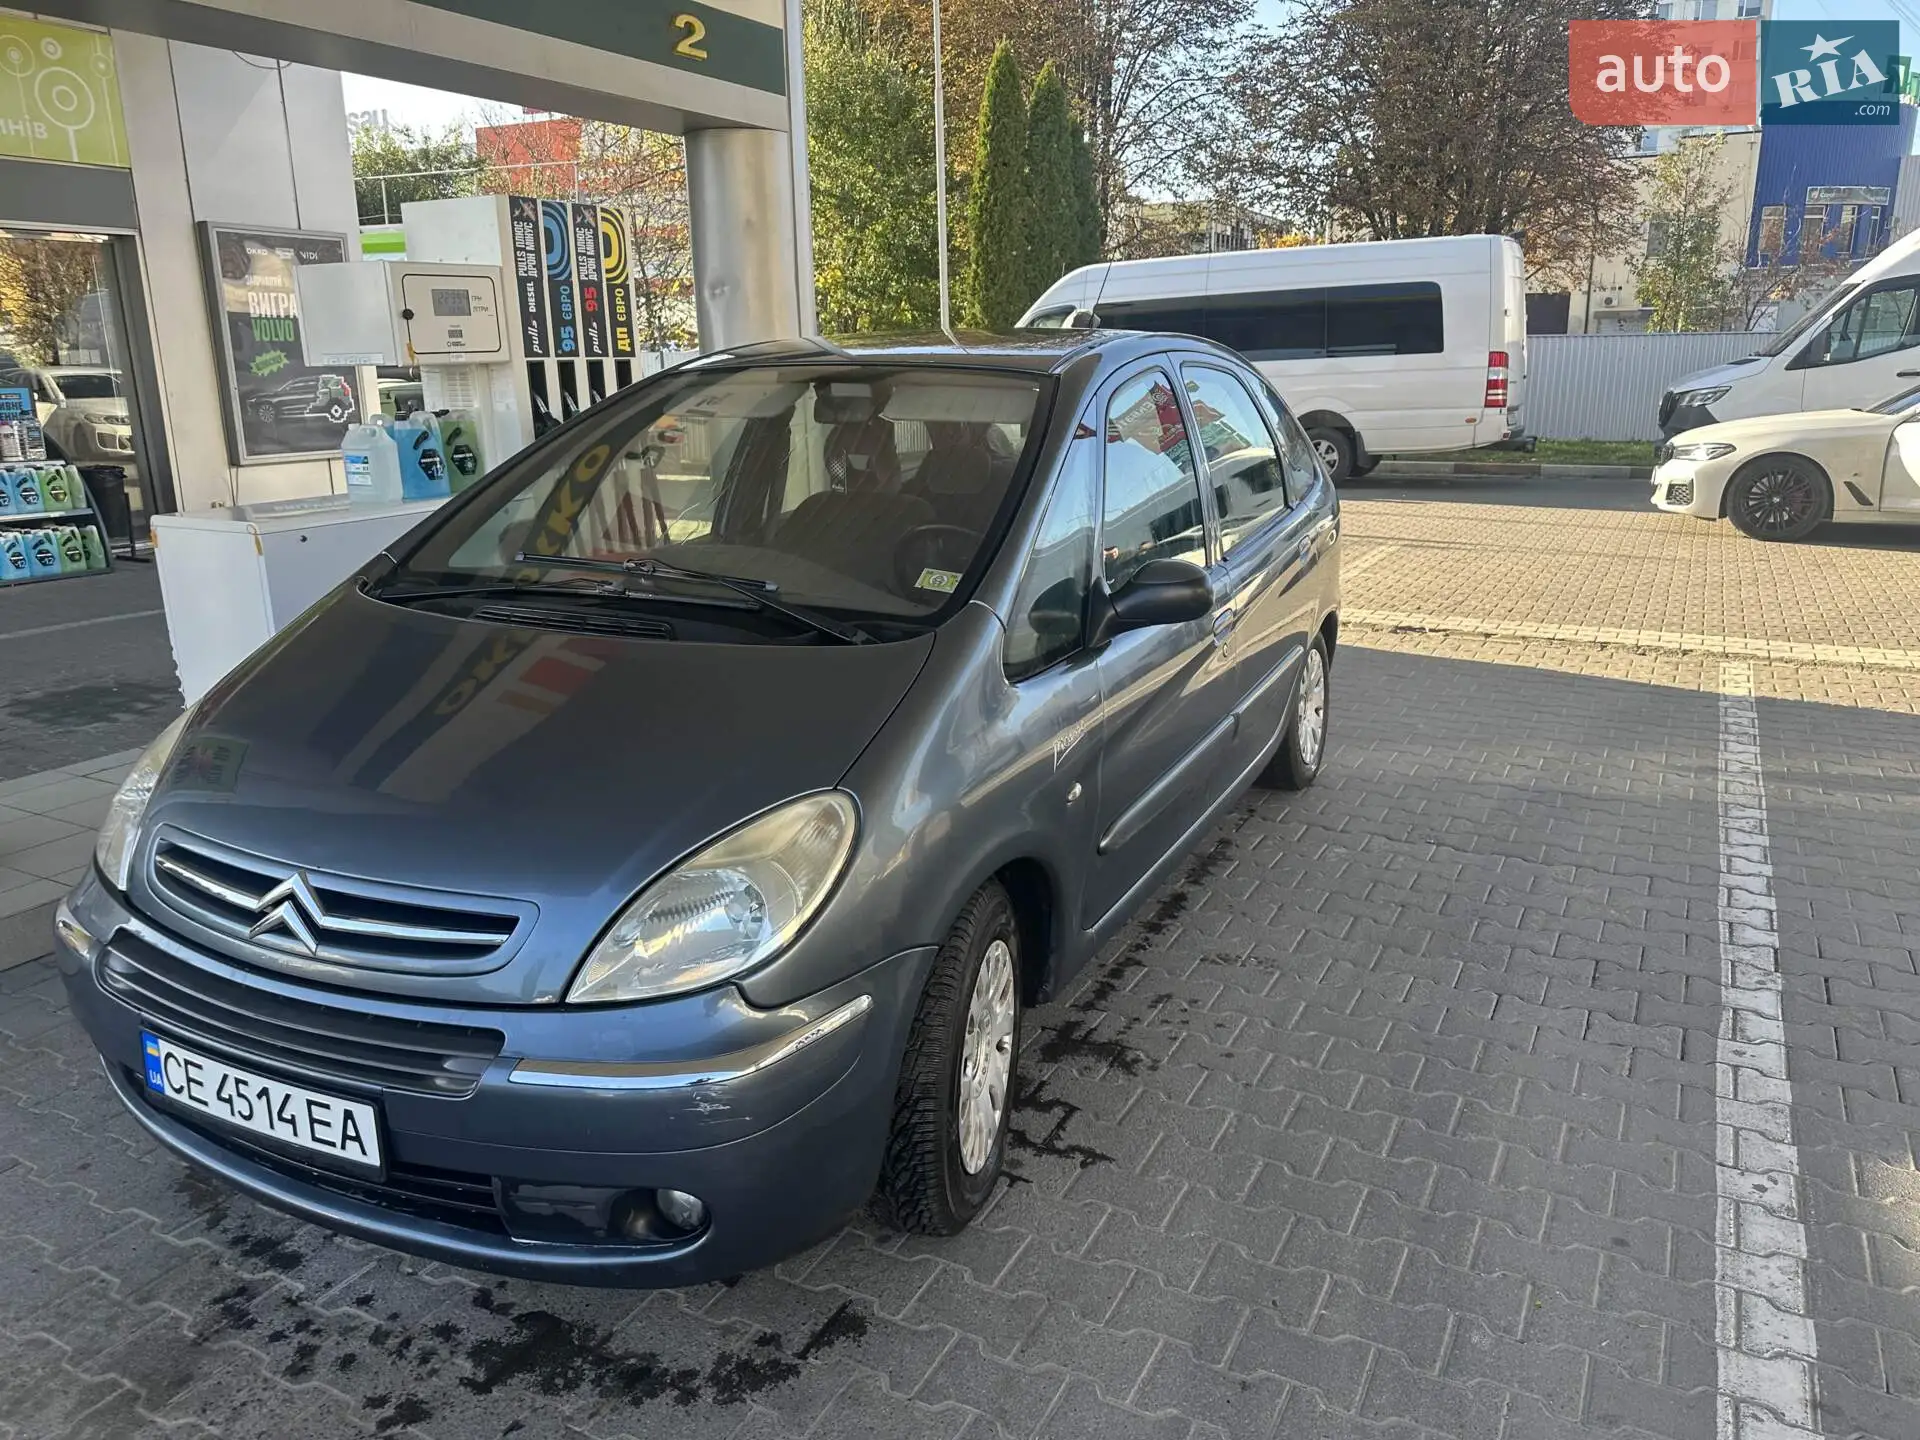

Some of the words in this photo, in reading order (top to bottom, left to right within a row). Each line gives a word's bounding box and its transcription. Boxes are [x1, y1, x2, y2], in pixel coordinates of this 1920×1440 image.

[674, 14, 708, 62] 2
[524, 222, 536, 251] МІНУС
[585, 228, 595, 255] МІНУС
[517, 250, 527, 277] PULLS
[526, 252, 538, 278] ДРОН
[578, 255, 588, 281] PULLS
[587, 254, 598, 281] ДРОН
[526, 281, 537, 313] DIESEL
[584, 286, 598, 311] 95
[251, 318, 296, 342] VOLVO
[527, 320, 543, 354] pulls
[560, 325, 576, 352] 95
[149, 1069, 164, 1088] UA
[163, 1051, 209, 1107] CE
[216, 1072, 299, 1138] 4514
[306, 1097, 369, 1157] EA
